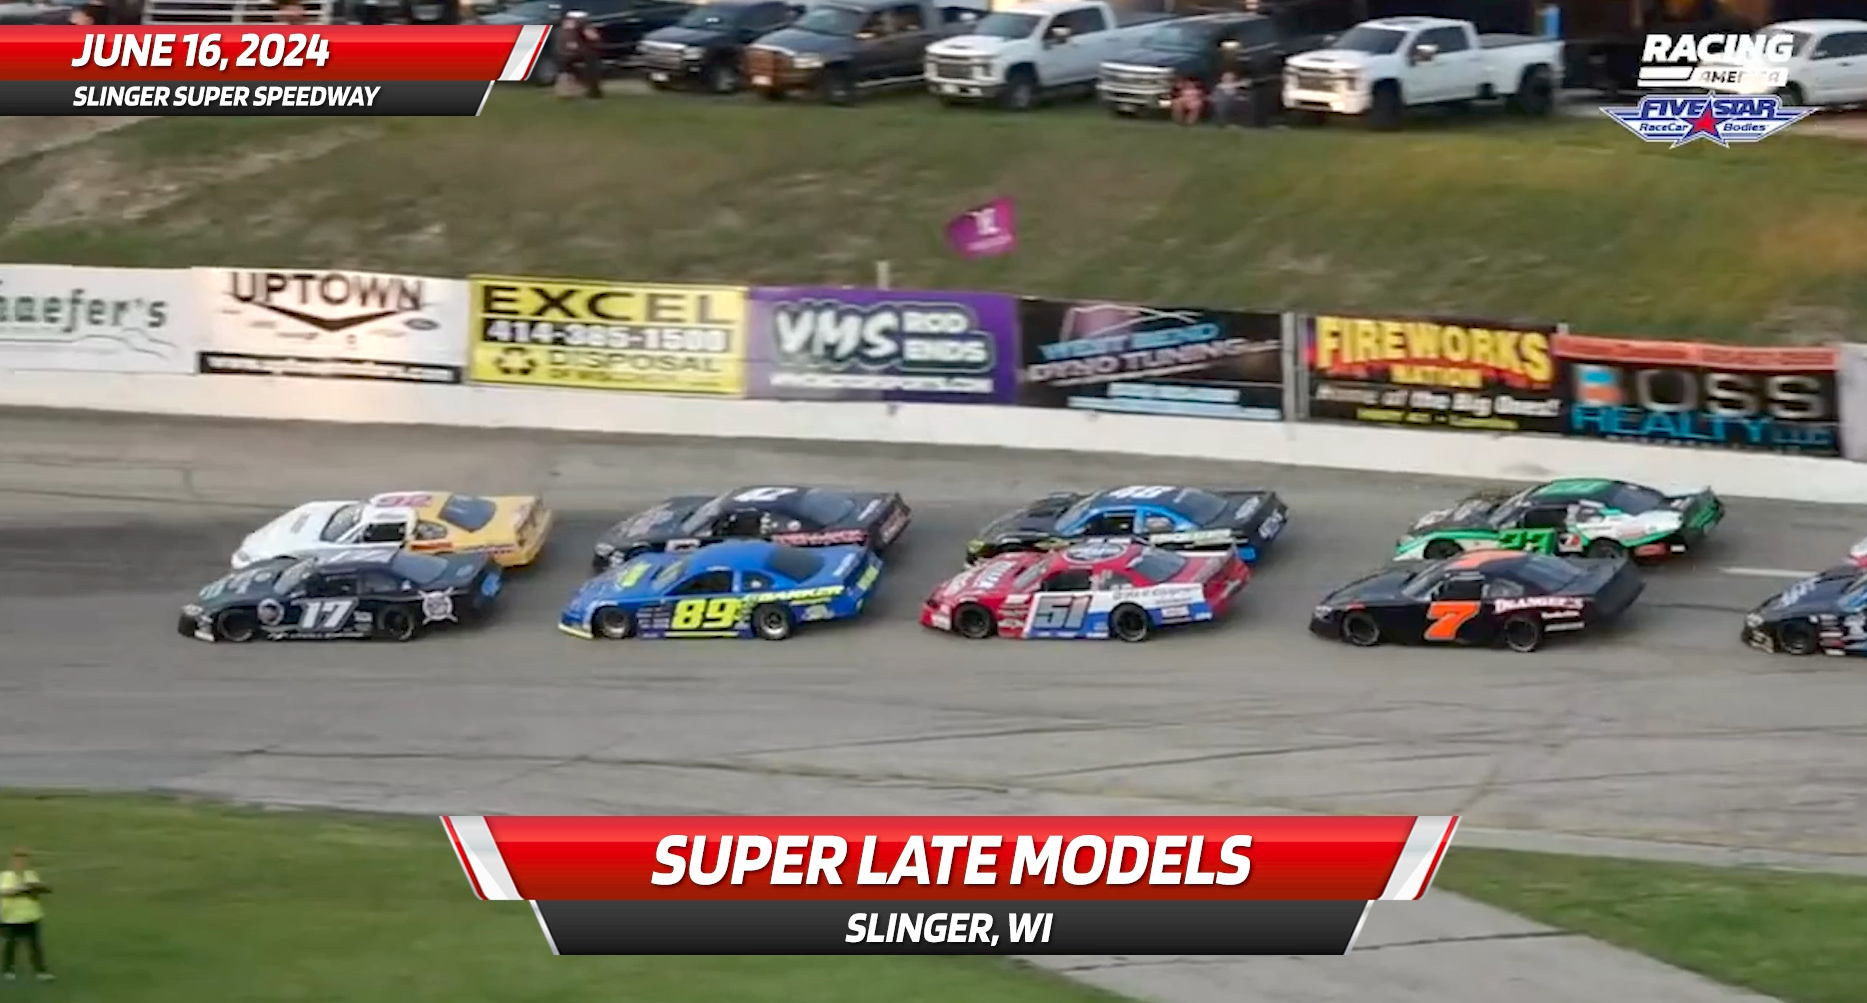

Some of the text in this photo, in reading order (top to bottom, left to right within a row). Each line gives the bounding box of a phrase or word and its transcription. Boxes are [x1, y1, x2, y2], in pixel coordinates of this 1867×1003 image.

[229, 271, 426, 310] UPTOWN
[482, 284, 737, 324] EXCEL
[776, 310, 900, 358] VMS
[903, 311, 968, 333] ROD
[550, 349, 723, 372] DISPOSAL
[1316, 315, 1552, 382] FIREWORKS
[1570, 405, 1770, 442] REALTY
[300, 600, 357, 630] 17
[671, 598, 739, 630] 89
[1033, 595, 1094, 629] 51
[1425, 600, 1481, 641] 7
